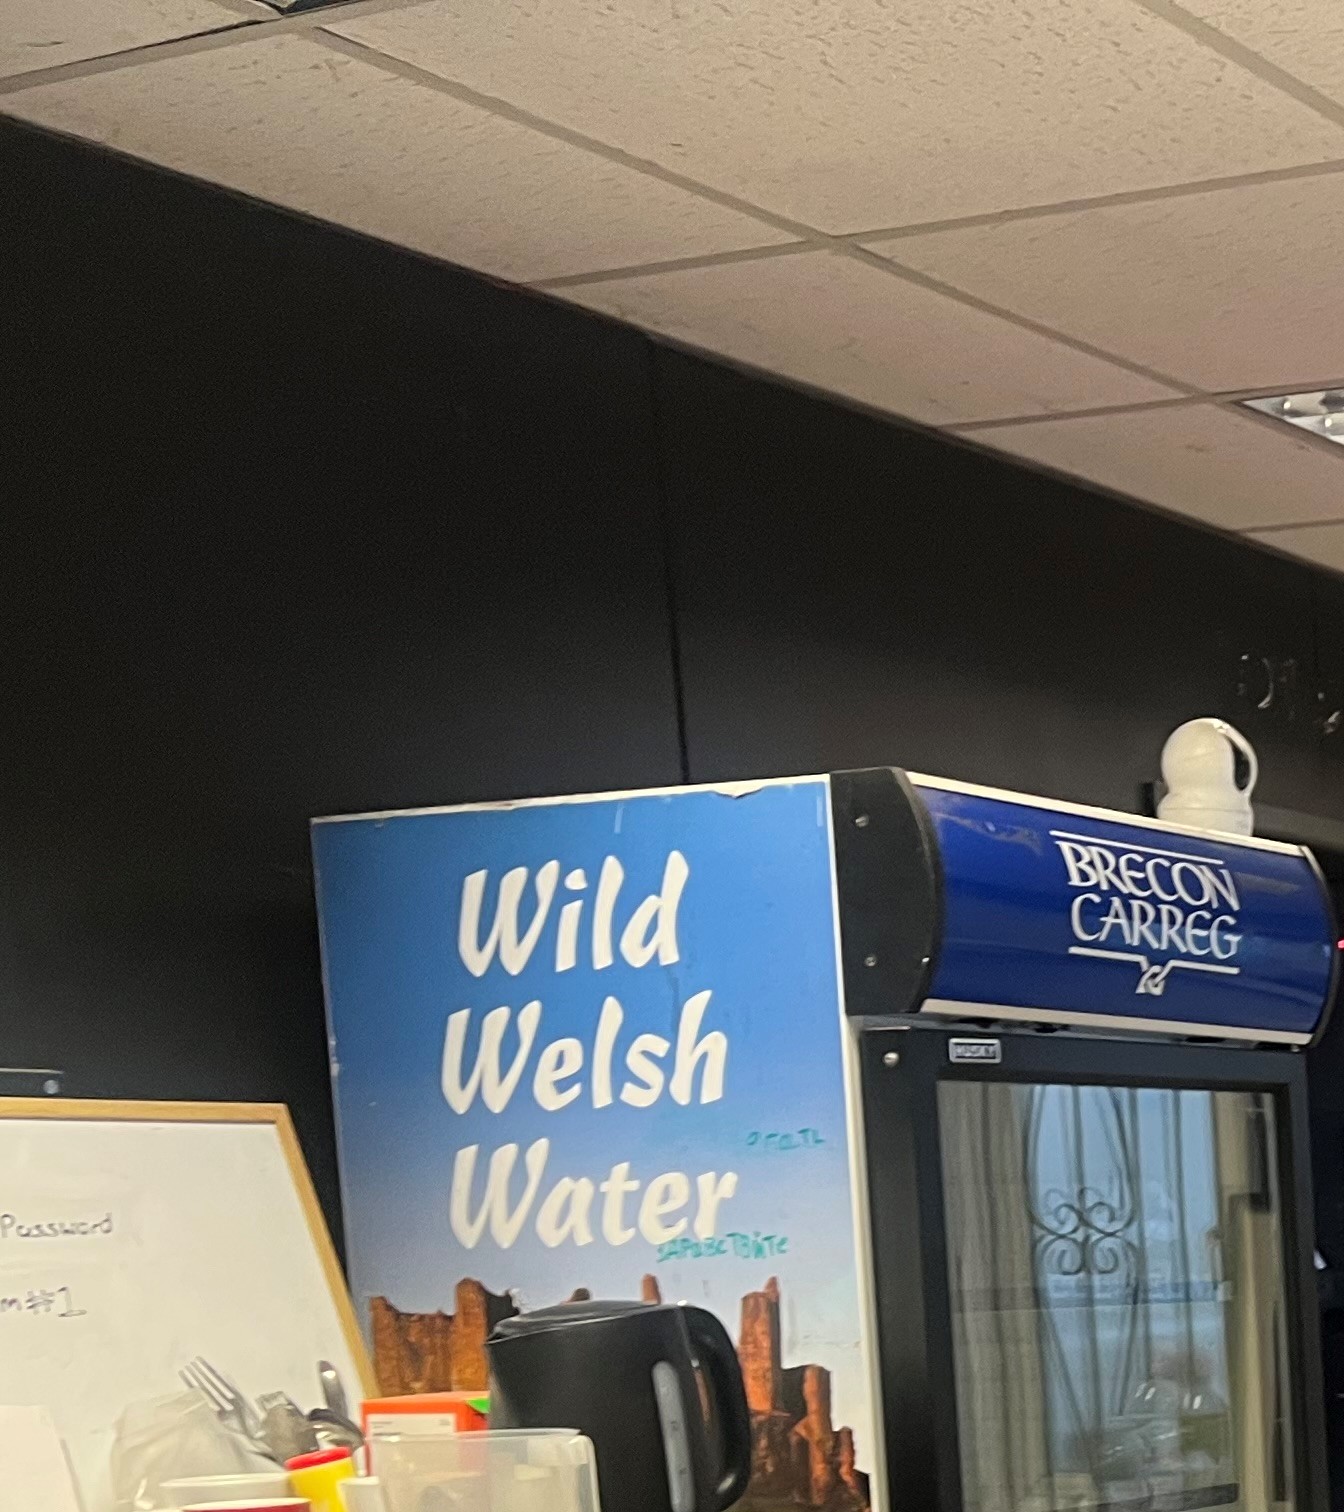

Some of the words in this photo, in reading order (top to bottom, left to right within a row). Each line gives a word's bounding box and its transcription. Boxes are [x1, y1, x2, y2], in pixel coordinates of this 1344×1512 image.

[457, 849, 690, 978] Wild
[1055, 840, 1241, 912] BRECON
[1071, 893, 1244, 960] CARREG
[441, 989, 729, 1115] Welsh
[449, 1137, 739, 1250] Water
